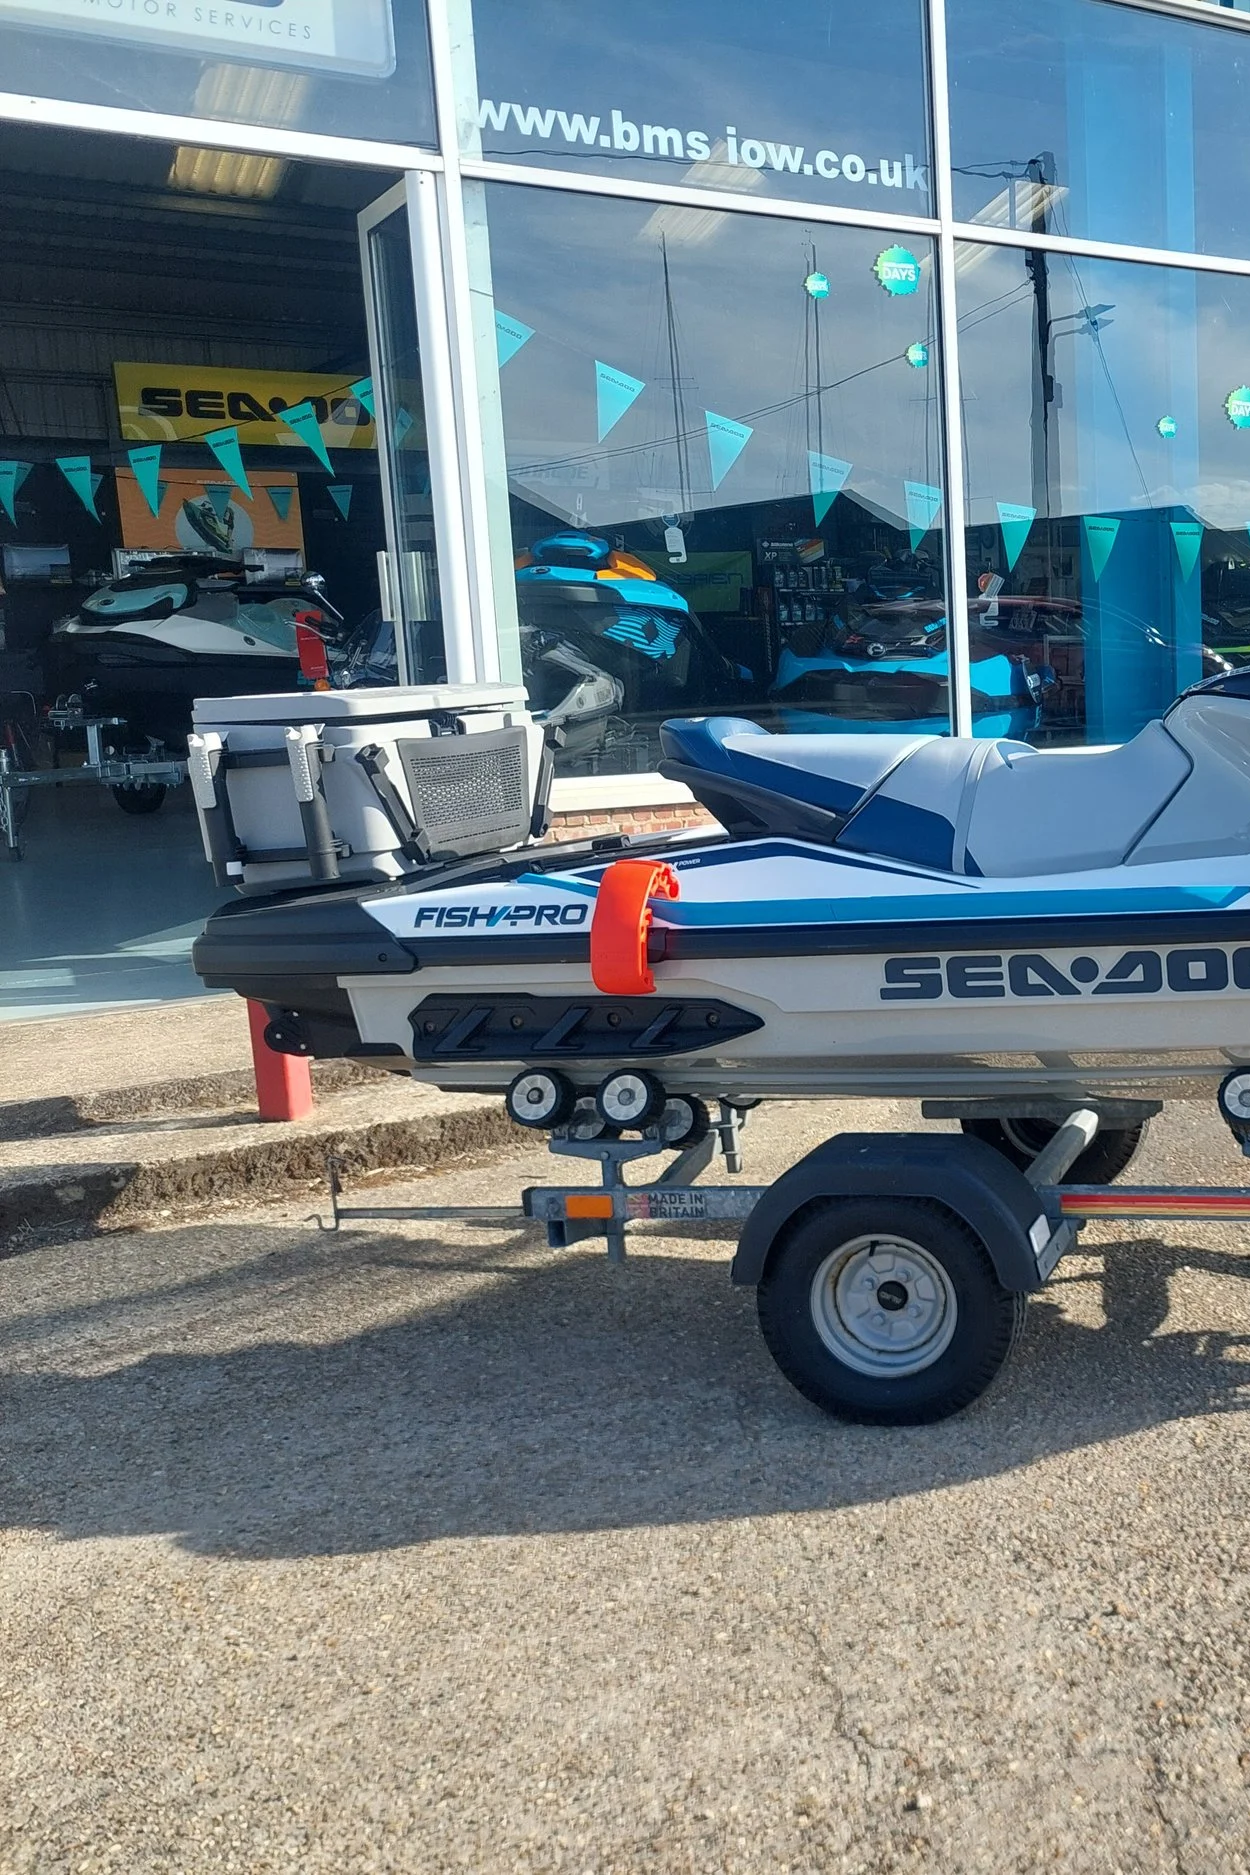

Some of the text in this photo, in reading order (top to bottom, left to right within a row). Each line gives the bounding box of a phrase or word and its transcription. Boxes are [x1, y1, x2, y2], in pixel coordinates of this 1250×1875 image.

[194, 7, 312, 40] SERVICES
[883, 268, 916, 282] DAYS
[677, 572, 744, 585] BRIEN
[678, 858, 701, 866] POWER
[648, 1193, 703, 1204] MADE IN
[649, 1206, 704, 1218] BRITAIN
